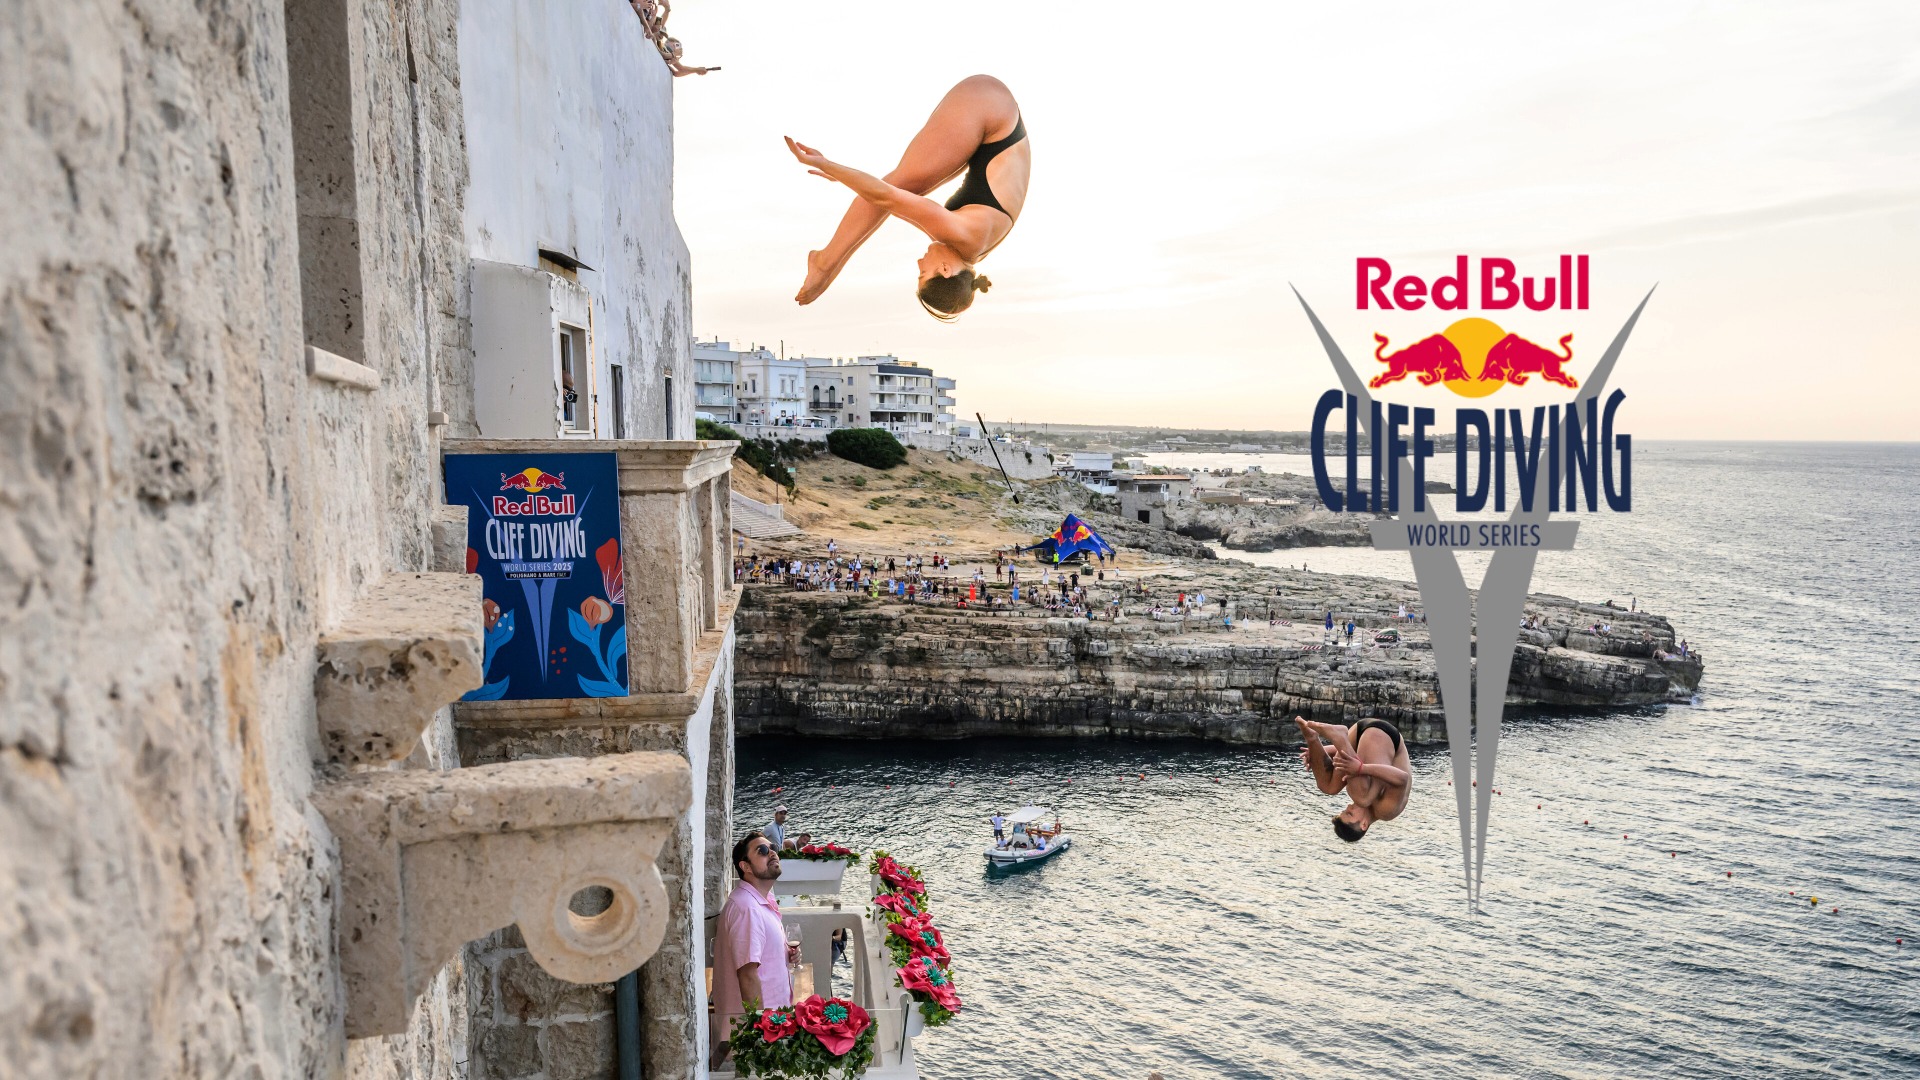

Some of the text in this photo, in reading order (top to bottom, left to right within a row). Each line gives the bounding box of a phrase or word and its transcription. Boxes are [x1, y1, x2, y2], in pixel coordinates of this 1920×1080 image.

[493, 494, 575, 516] Red Bull
[485, 516, 586, 560] CLIFF DIVING
[503, 562, 572, 572] WORLD SERIES 2025
